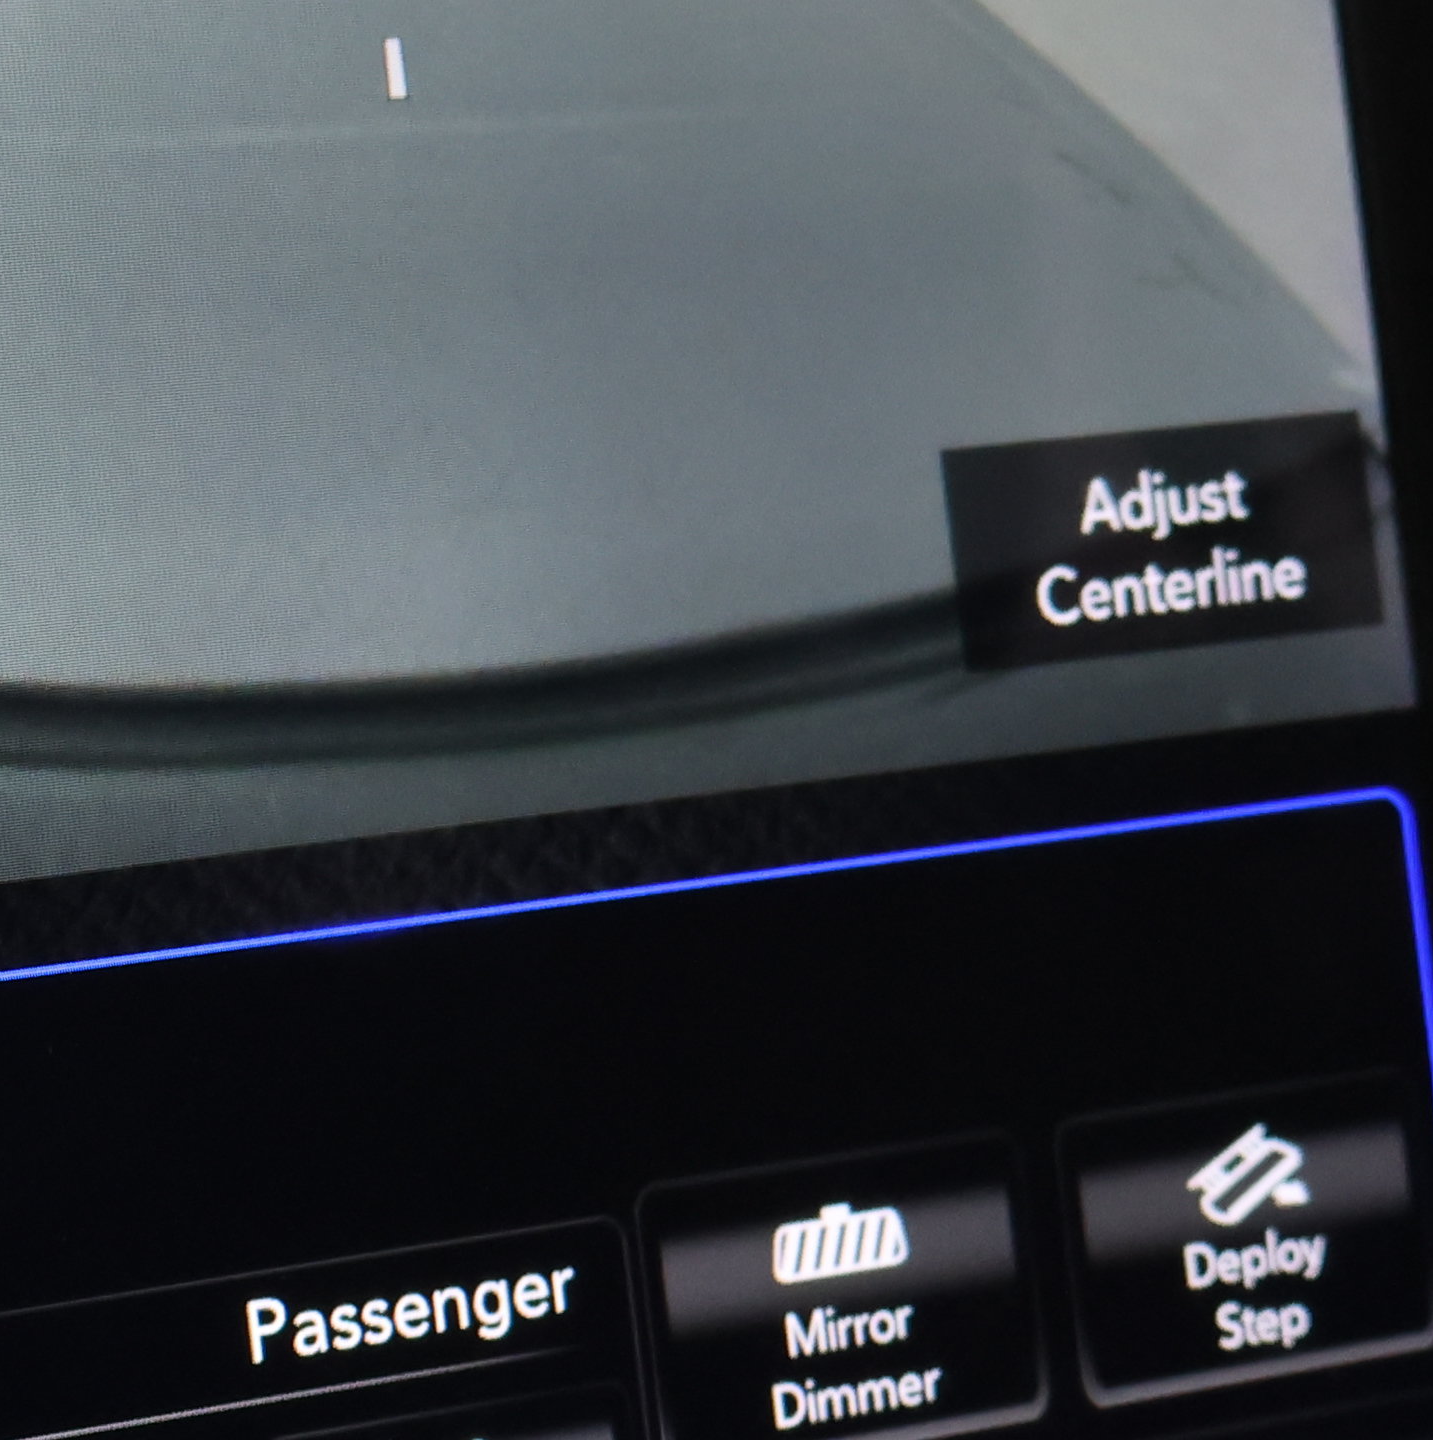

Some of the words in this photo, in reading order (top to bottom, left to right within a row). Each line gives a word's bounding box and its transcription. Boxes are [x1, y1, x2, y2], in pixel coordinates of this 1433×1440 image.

[1079, 469, 1251, 540] Adjust
[1036, 546, 1308, 627] Centerline
[1183, 1228, 1327, 1290] Deploy
[245, 1266, 575, 1364] Passenger
[784, 1303, 914, 1359] Mirror
[1215, 1299, 1310, 1355] Step
[771, 1366, 942, 1430] Dimmer
